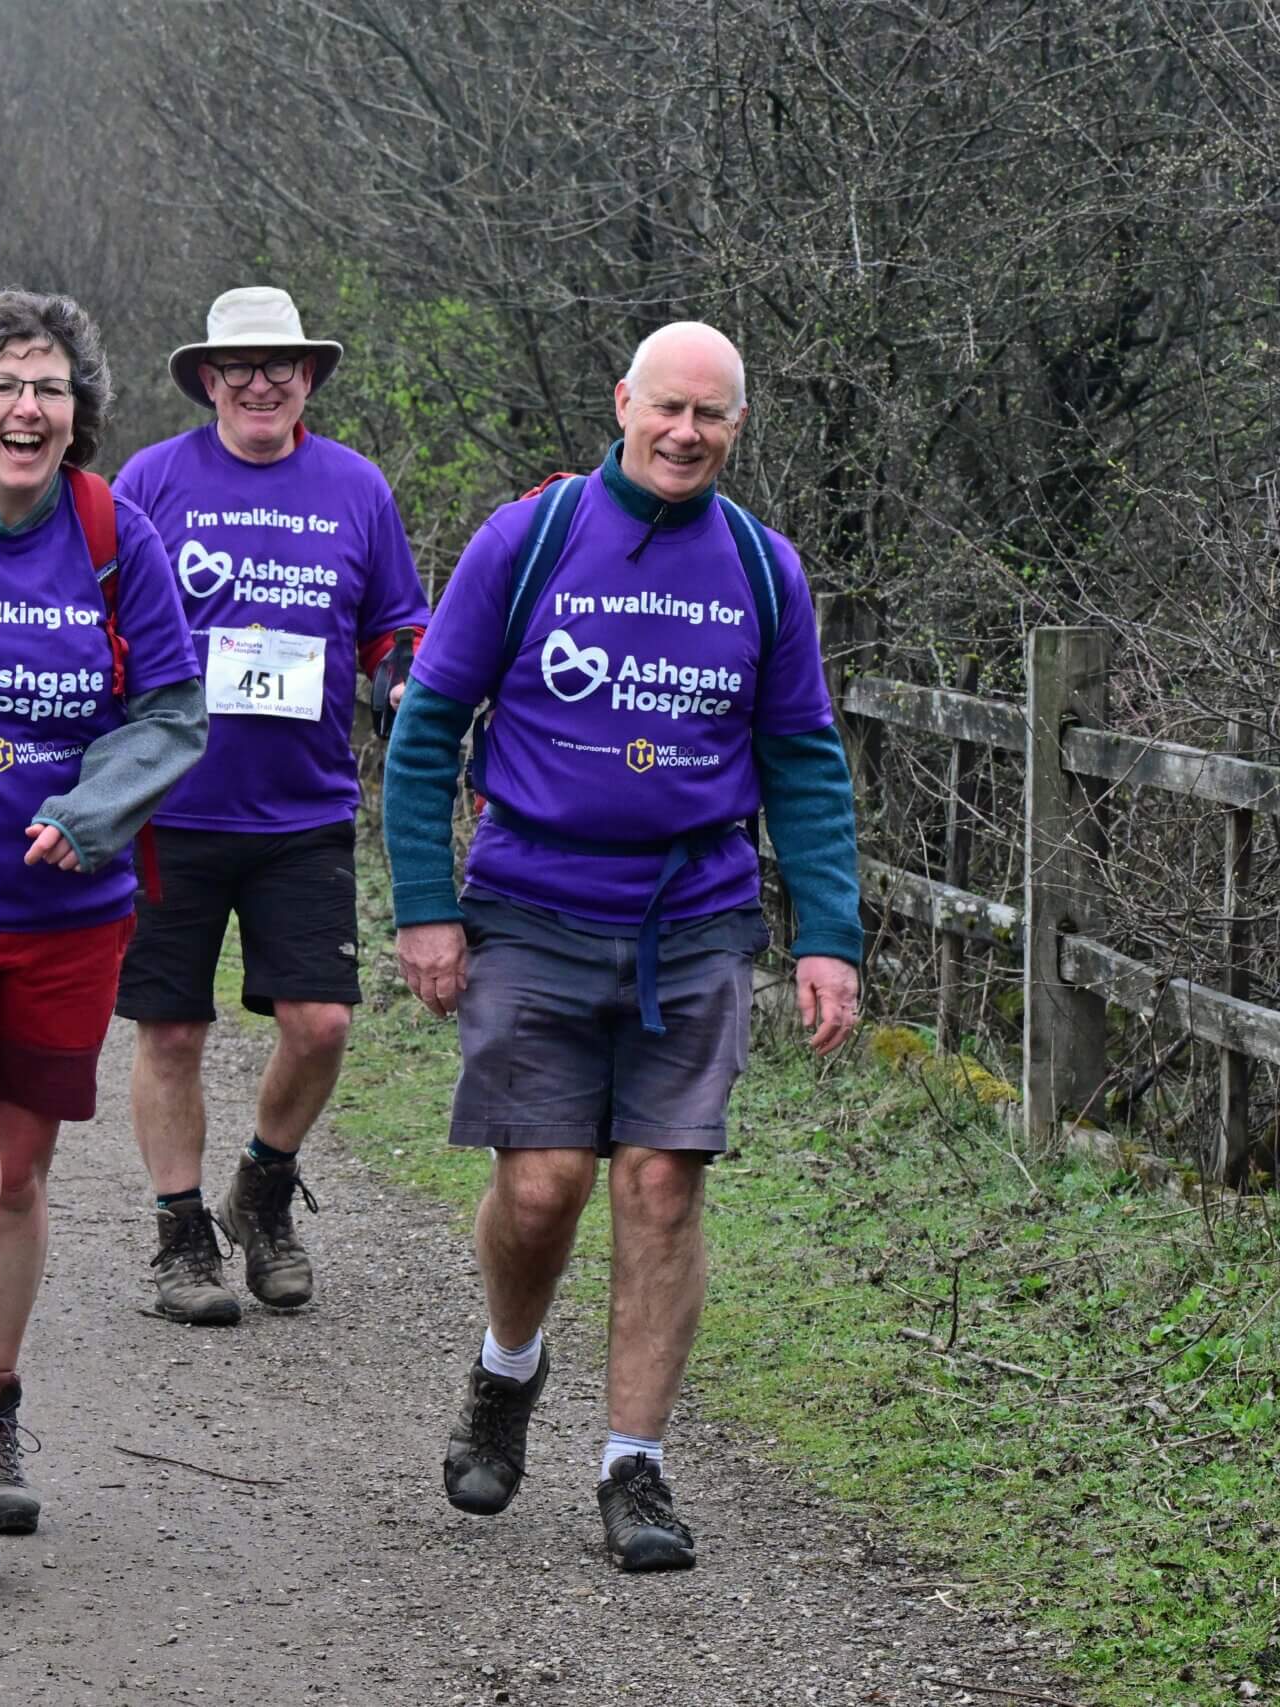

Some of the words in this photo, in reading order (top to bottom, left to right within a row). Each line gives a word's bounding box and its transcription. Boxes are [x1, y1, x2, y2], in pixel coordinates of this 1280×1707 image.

[186, 510, 217, 528] I'm
[222, 508, 304, 533] walking
[308, 515, 339, 534] for
[239, 557, 338, 586] Ashgate
[234, 580, 331, 608] Hospice
[65, 606, 100, 626] for
[555, 592, 594, 616] I'm
[601, 591, 703, 624] walking
[710, 600, 744, 626] for
[237, 669, 285, 700] 451
[618, 655, 742, 693] Ashgate
[294, 706, 313, 715] 2025
[611, 684, 732, 719] Hospice
[15, 743, 35, 753] WE
[36, 741, 54, 752] DO
[16, 745, 84, 764] WORKWEAR
[575, 744, 611, 753] sponsored
[612, 746, 621, 755] by
[656, 745, 677, 756] WE
[678, 746, 695, 756] DO
[656, 755, 720, 767] WORKWEAR
